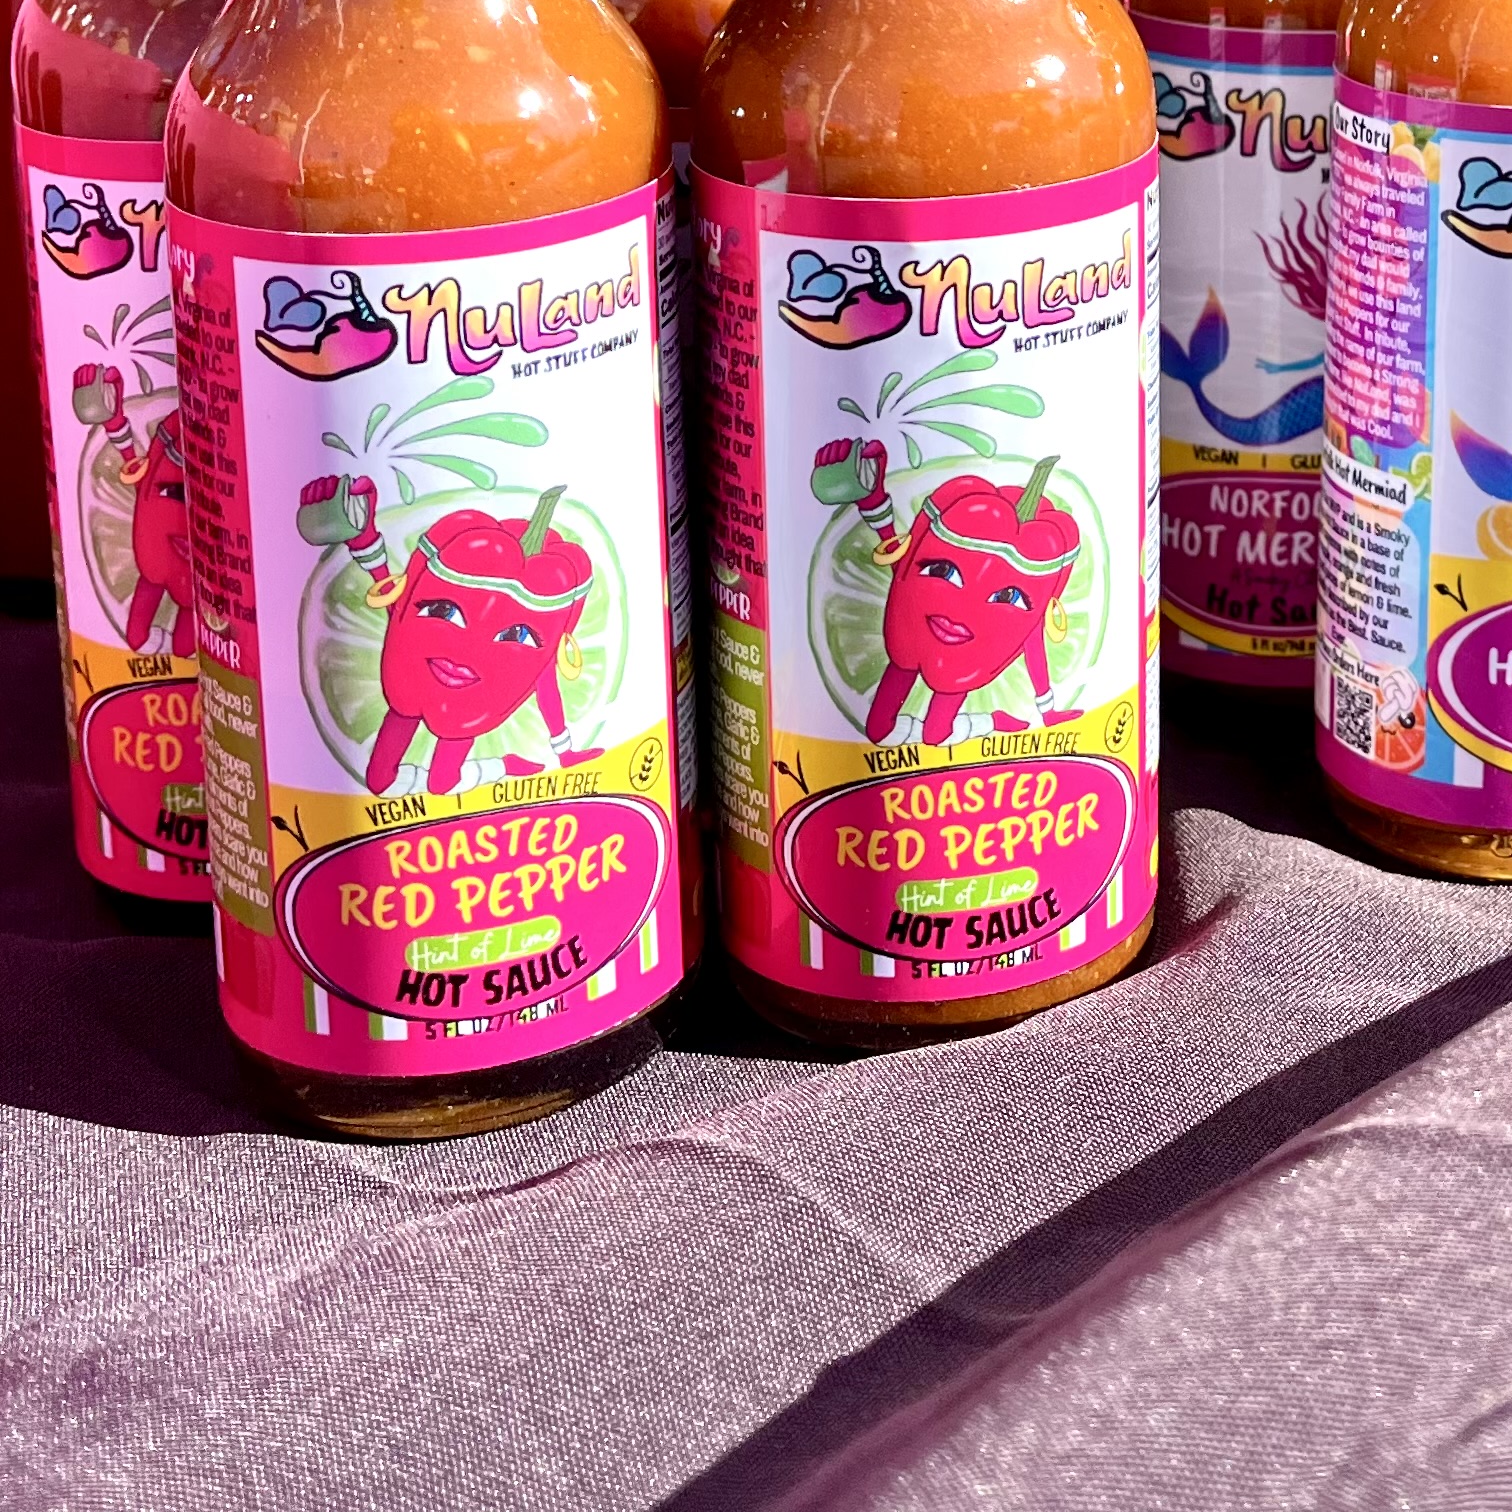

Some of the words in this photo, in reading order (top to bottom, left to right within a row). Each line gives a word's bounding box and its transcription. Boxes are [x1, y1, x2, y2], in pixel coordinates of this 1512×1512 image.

[1334, 105, 1350, 135] Our
[1351, 115, 1391, 156] Story
[1381, 185, 1425, 206] traveled
[1393, 226, 1427, 244] called
[1412, 246, 1426, 262] of
[1395, 297, 1422, 319] land
[1013, 334, 1041, 353] HOT
[1042, 324, 1084, 349] STUFF
[1085, 308, 1129, 338] COMPANY
[1390, 318, 1411, 333] our
[214, 335, 236, 355] our
[511, 359, 542, 380] HOT
[543, 347, 590, 374] STUFF
[590, 328, 640, 360] COMPANY
[1381, 368, 1421, 395] Strong
[1392, 392, 1417, 410] was
[1391, 409, 1414, 427] and
[1192, 444, 1239, 467] VEGAN
[236, 528, 249, 550] in
[1162, 512, 1228, 558] HOT
[1374, 522, 1411, 548] Smoky
[215, 547, 252, 575] Brand
[1393, 548, 1405, 562] of
[1389, 565, 1400, 579] of
[1374, 576, 1401, 597] fresh
[1206, 583, 1261, 622] Hot
[1372, 614, 1389, 630] our
[750, 644, 760, 666] &
[127, 656, 173, 679] VEGAN
[735, 661, 764, 688] never
[1356, 661, 1380, 686] Here
[242, 694, 253, 717] &
[228, 712, 258, 740] never
[750, 726, 760, 746] &
[112, 725, 184, 774] RED
[863, 745, 921, 774] VEGAN
[980, 732, 1042, 758] GLUTEN
[1045, 731, 1082, 755] FREE
[246, 781, 256, 801] &
[365, 795, 428, 828] VEGAN
[492, 777, 557, 805] GLUTEN
[562, 770, 603, 796] FREE
[750, 787, 770, 809] you
[880, 770, 1059, 824] ROASTED
[239, 798, 248, 818] of
[738, 801, 760, 824] how
[835, 825, 926, 872] RED
[940, 792, 1100, 870] PEPPER
[247, 844, 269, 868] you
[384, 814, 579, 880] ROASTED
[237, 861, 259, 885] how
[338, 881, 437, 931] RED
[450, 833, 627, 924] PEPPER
[900, 880, 954, 912] Hint
[955, 877, 978, 907] of
[982, 871, 1038, 902] Lime
[886, 910, 954, 950] HOT
[965, 888, 1062, 950] SAUCE
[411, 936, 460, 974] Hint
[470, 932, 495, 962] of
[498, 924, 560, 961] Lime
[395, 968, 470, 1009] HOT
[482, 934, 588, 1007] SAUCE
[911, 961, 923, 979] 5
[424, 1020, 437, 1041] 5
[545, 994, 570, 1016] ML
